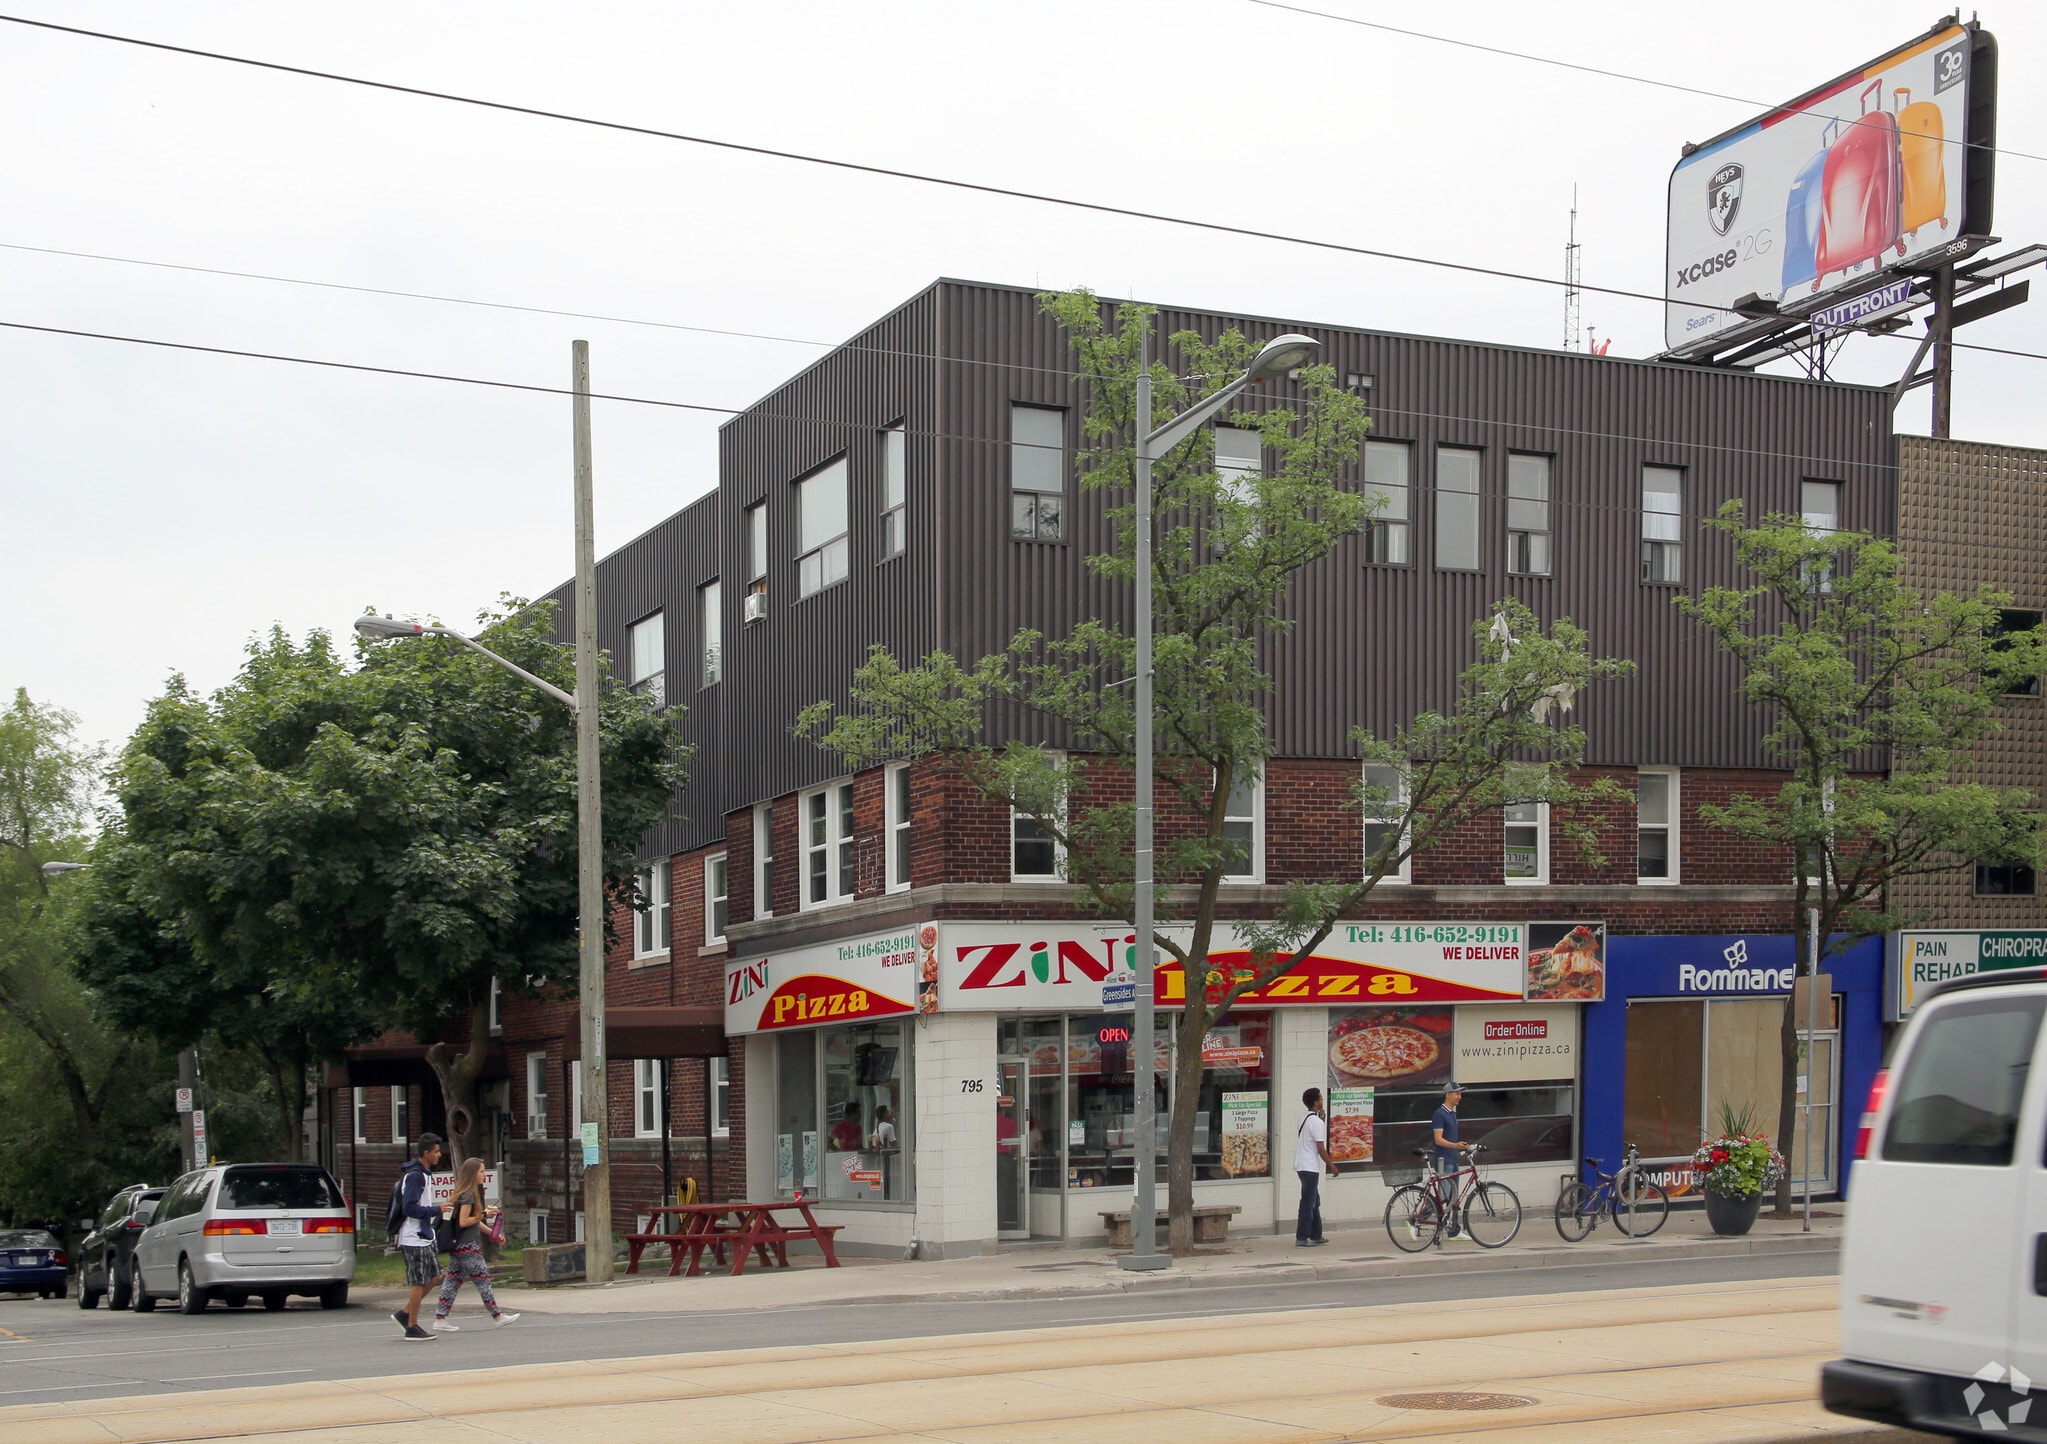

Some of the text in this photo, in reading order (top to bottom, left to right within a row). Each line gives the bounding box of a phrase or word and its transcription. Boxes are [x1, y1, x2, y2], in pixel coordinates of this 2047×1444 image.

[1940, 51, 1963, 82] 30
[1715, 167, 1735, 183] HEYS
[1742, 229, 1772, 262] 2G
[1946, 238, 1968, 256] 3596
[1814, 282, 1906, 332] OUTFRONT
[1686, 313, 1715, 331] Sears
[1506, 853, 1529, 862] HILL
[1346, 926, 1519, 943] Tel: 416-652-9191
[838, 934, 915, 961] Tel: 416-652-9191
[1443, 947, 1519, 960] WE DELIVER
[1916, 942, 1947, 957] PAIN
[881, 951, 915, 969] WE DELIVER
[1914, 963, 1976, 982] REHAB
[1103, 988, 1131, 1001] Greensides
[773, 990, 870, 1023] Pizza
[1099, 1028, 1129, 1042] OPEN
[1486, 1022, 1546, 1037] Order Online
[1461, 1042, 1570, 1060] www.zinipizza.ca
[961, 1079, 983, 1093] 795
[1236, 1122, 1254, 1130] $10.99
